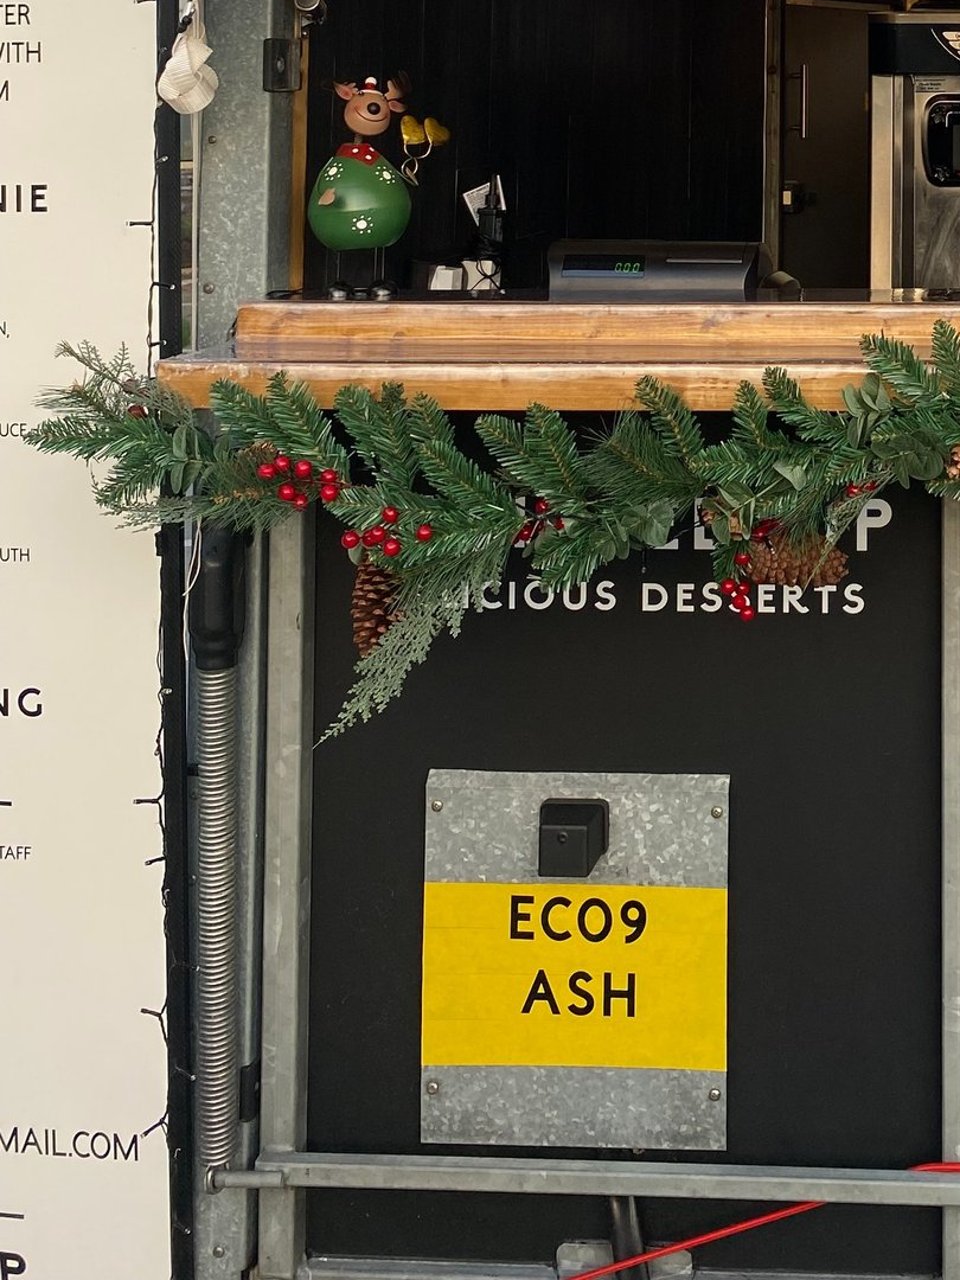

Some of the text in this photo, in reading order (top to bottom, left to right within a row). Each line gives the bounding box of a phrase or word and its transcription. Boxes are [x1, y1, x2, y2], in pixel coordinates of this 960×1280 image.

[0, 3, 31, 25] ER
[0, 41, 41, 64] ITH
[521, 969, 636, 1018] ASH
